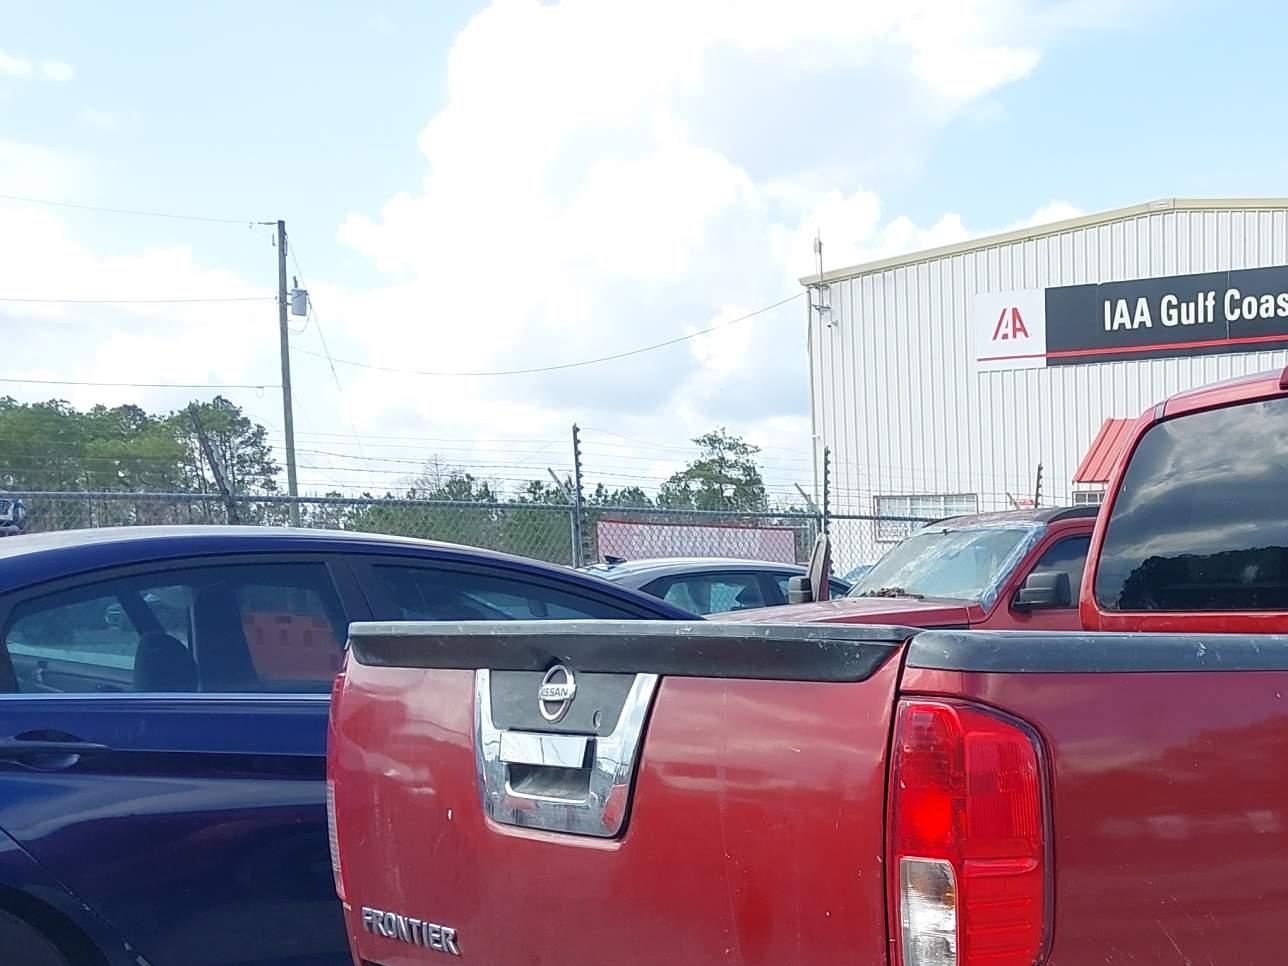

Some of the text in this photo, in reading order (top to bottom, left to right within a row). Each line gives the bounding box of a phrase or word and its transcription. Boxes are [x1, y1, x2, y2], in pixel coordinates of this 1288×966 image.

[1104, 297, 1153, 331] IAA
[1160, 290, 1216, 327] Gulf
[539, 686, 569, 698] ISSAN
[361, 906, 463, 957] FRONTIER
